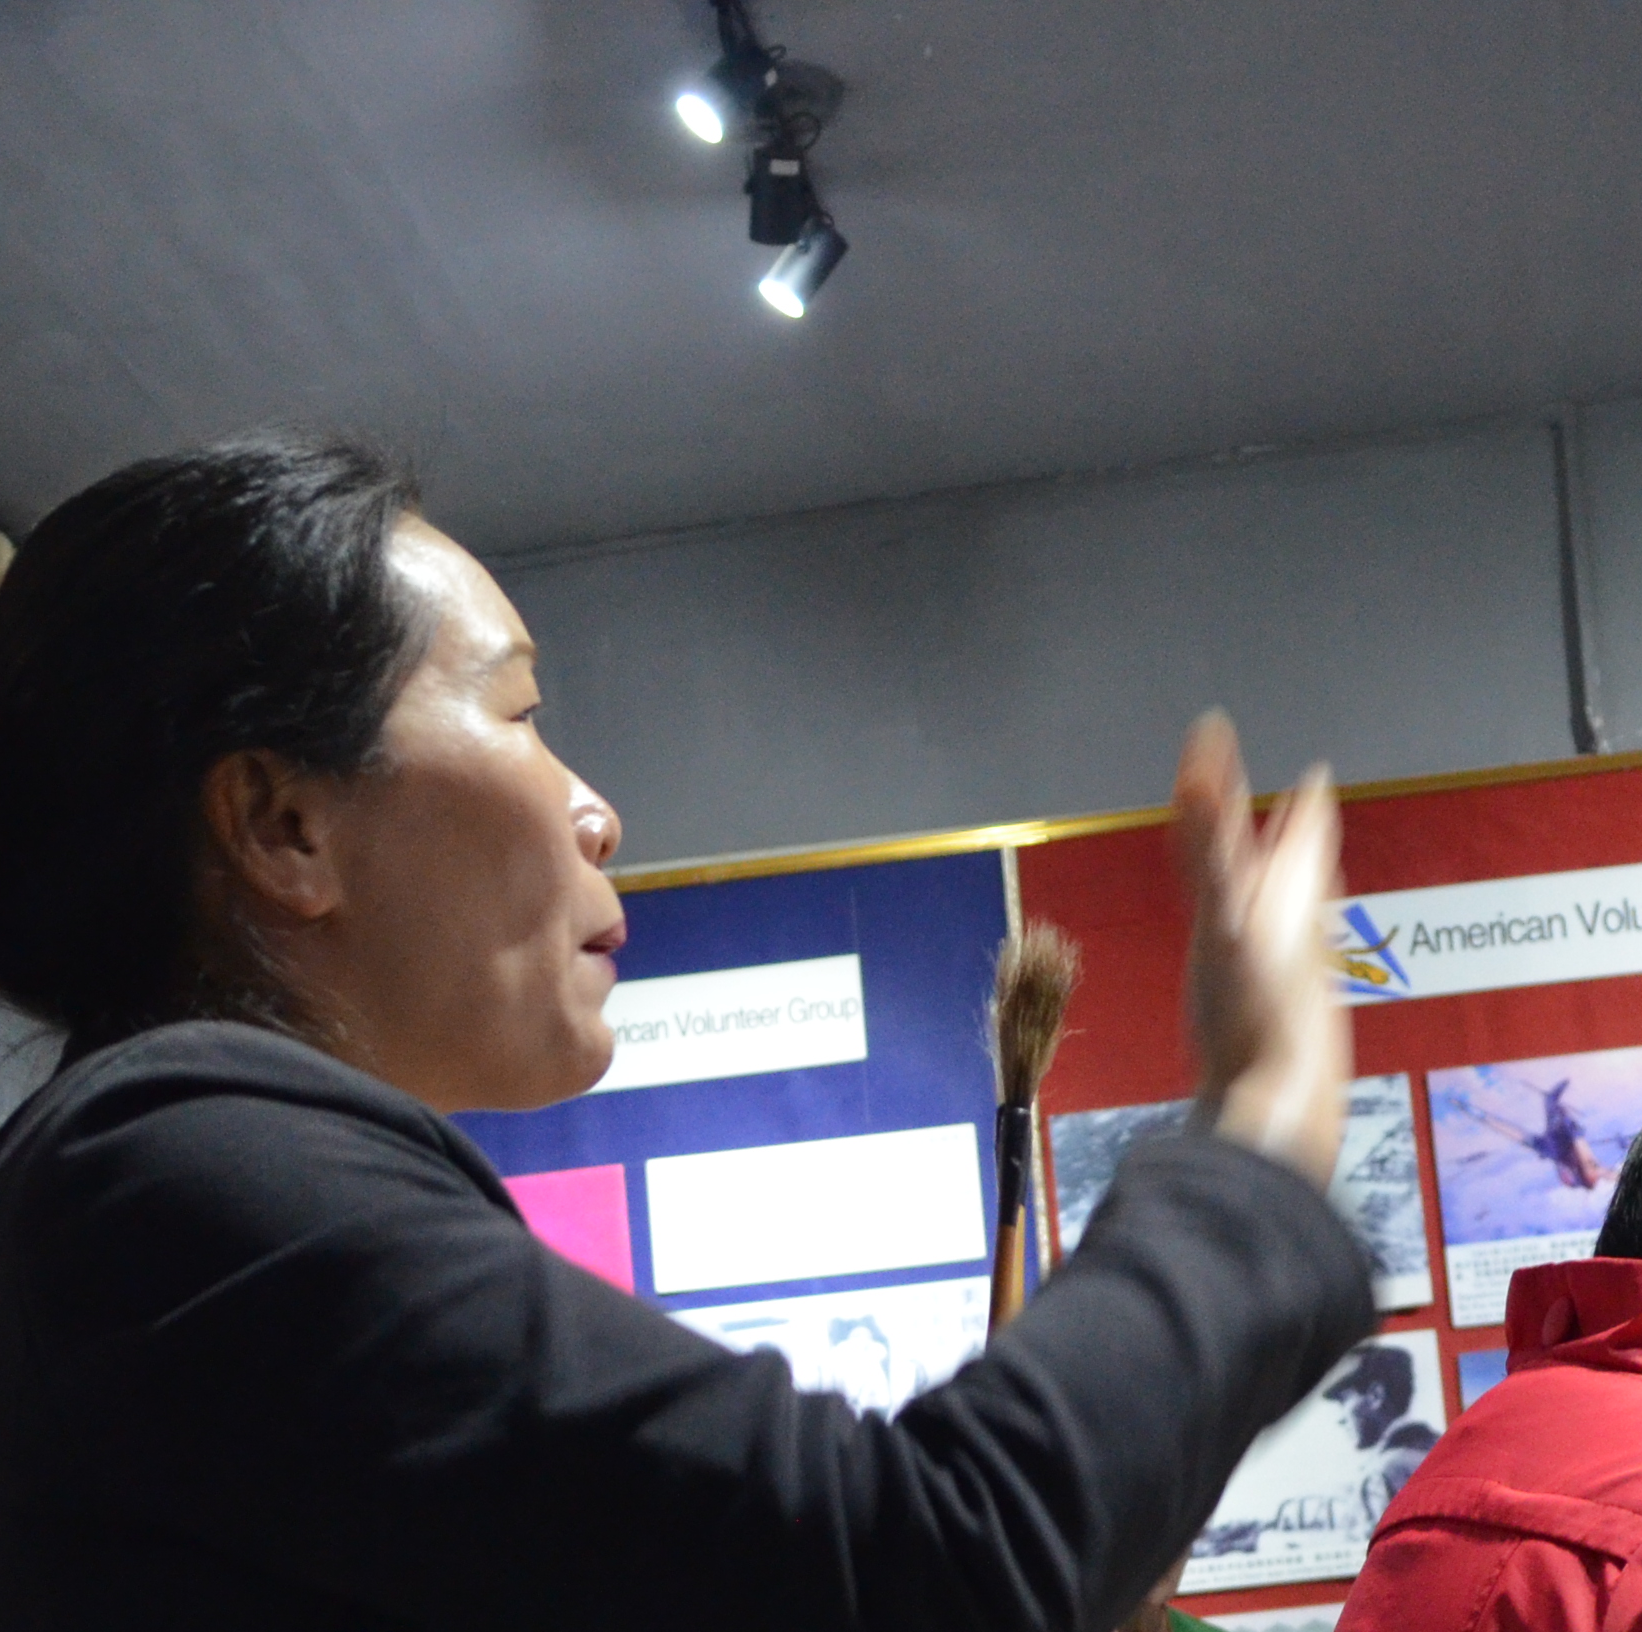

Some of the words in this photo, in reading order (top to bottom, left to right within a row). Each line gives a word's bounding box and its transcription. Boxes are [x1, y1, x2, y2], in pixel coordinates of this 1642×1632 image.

[1409, 911, 1568, 957] American
[673, 1005, 782, 1038] Volunteer
[787, 996, 860, 1024] Group
